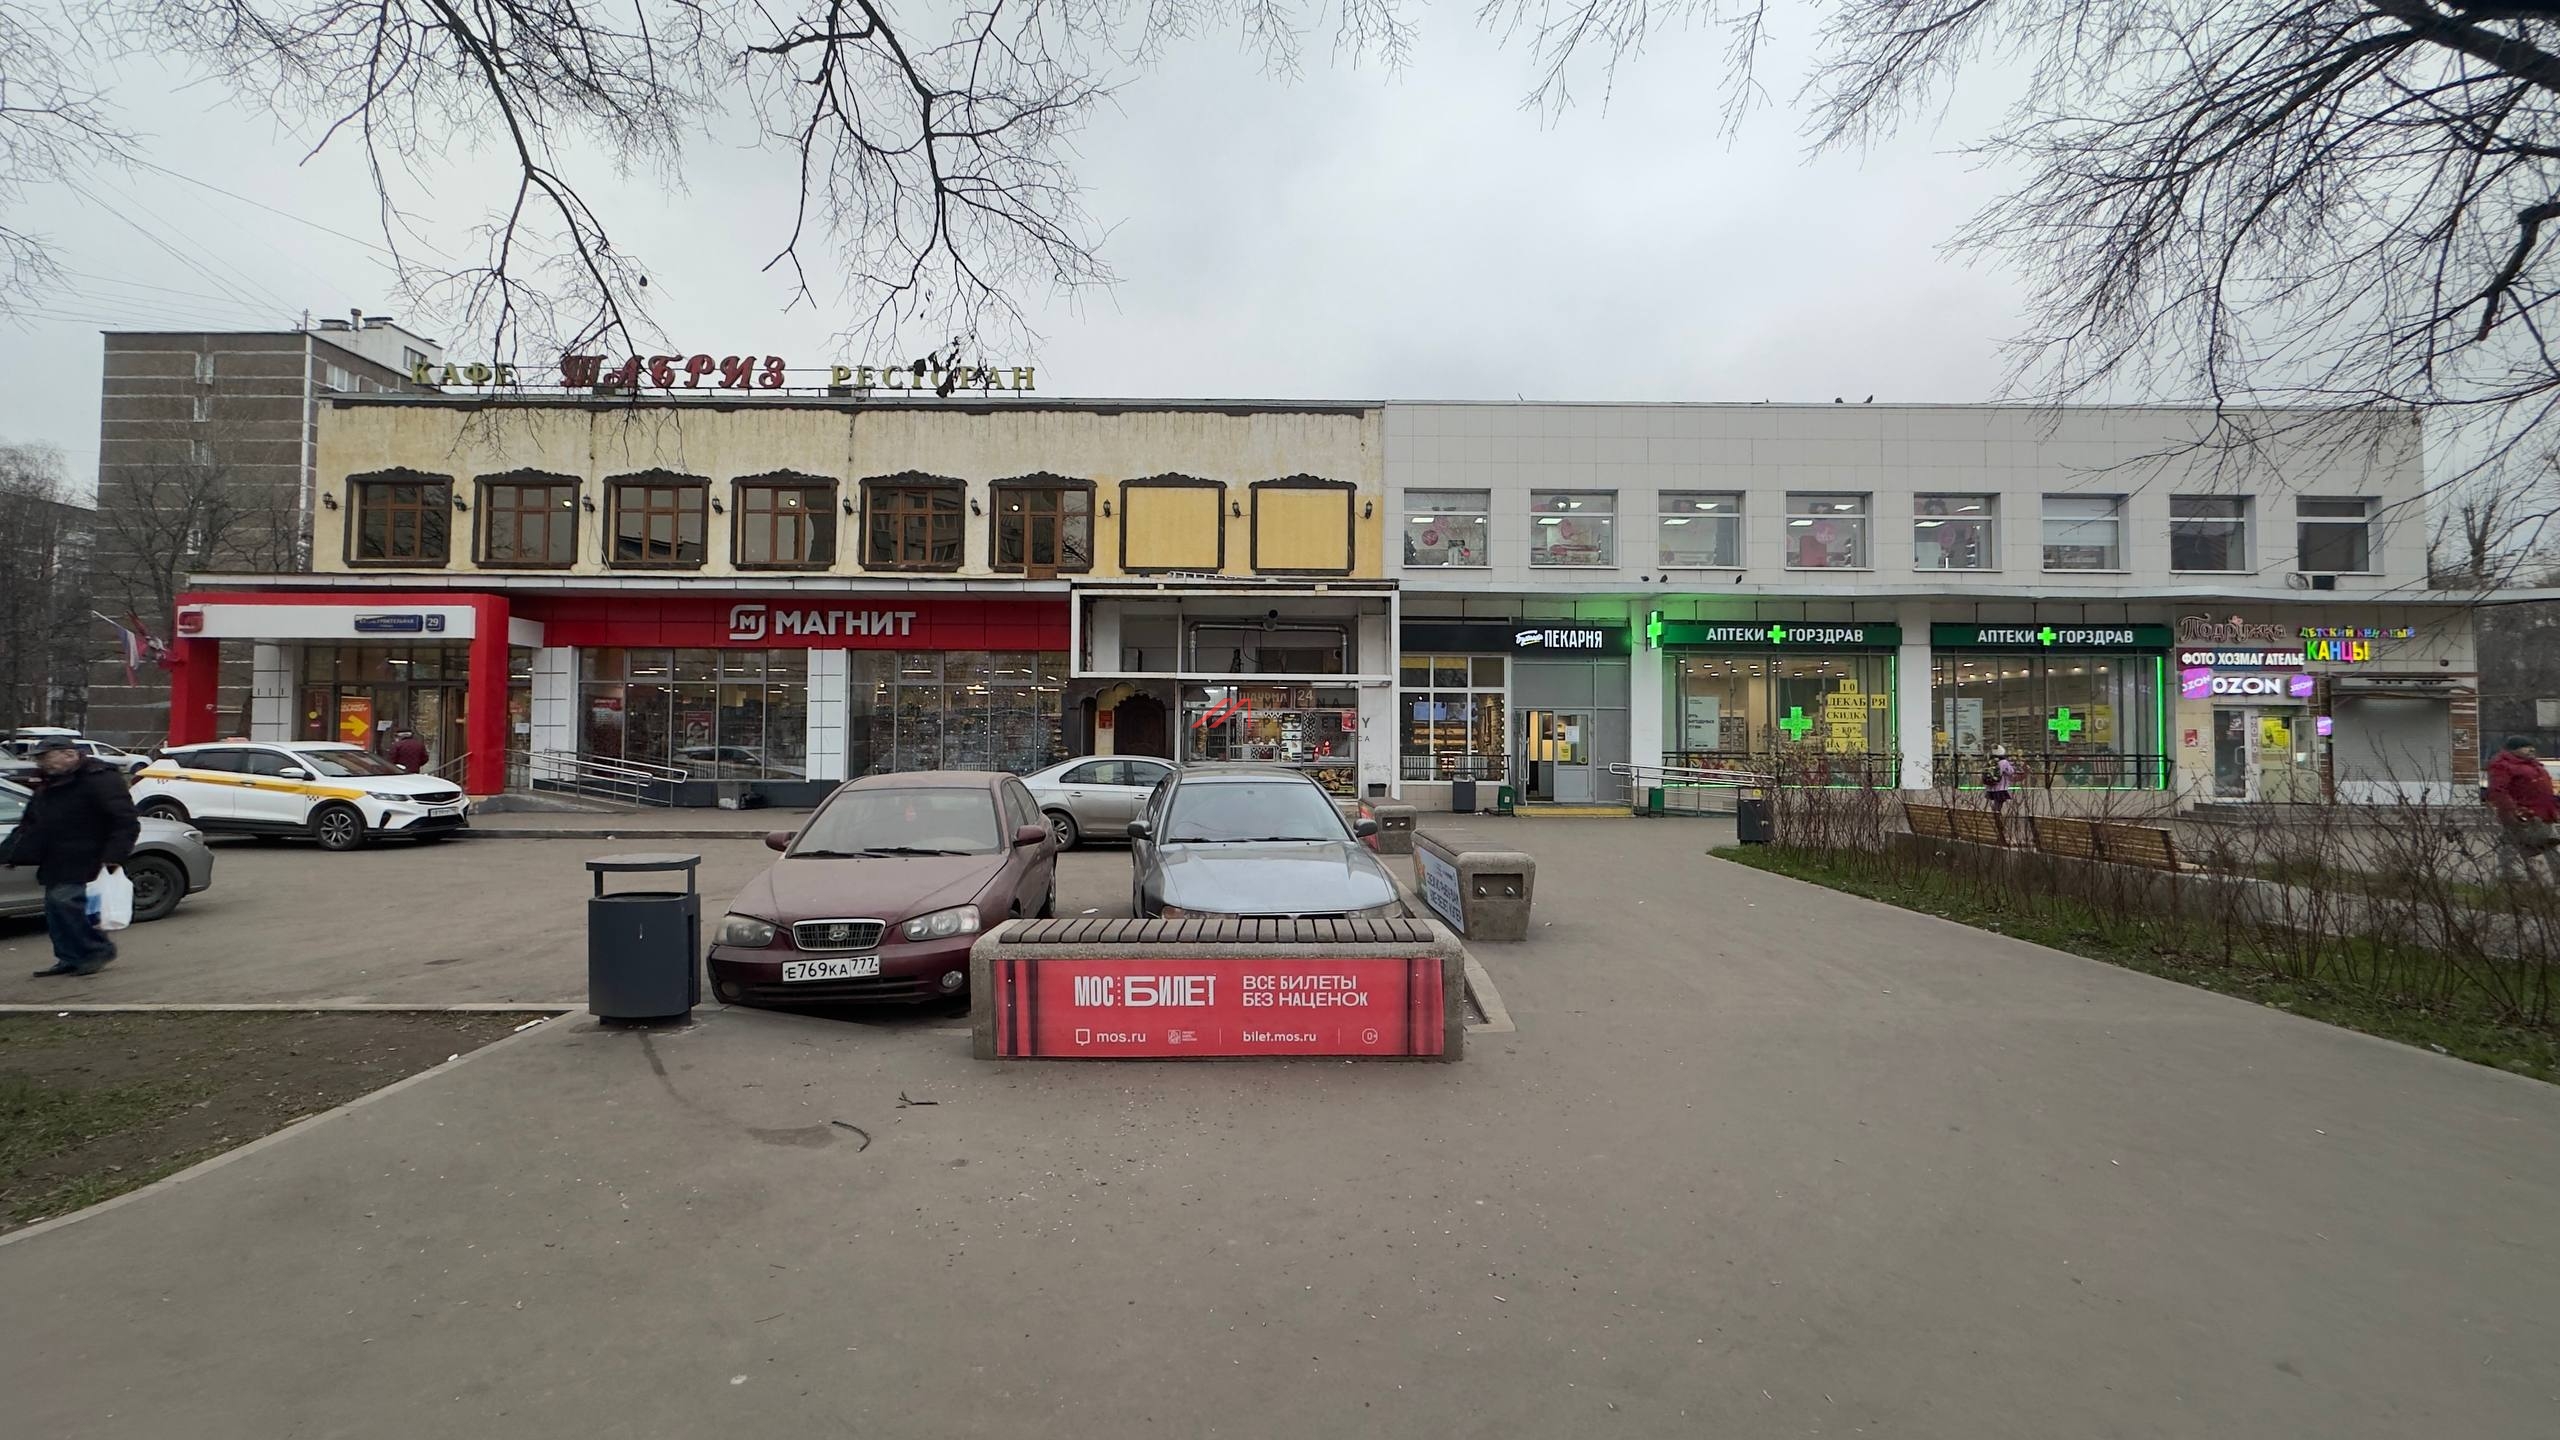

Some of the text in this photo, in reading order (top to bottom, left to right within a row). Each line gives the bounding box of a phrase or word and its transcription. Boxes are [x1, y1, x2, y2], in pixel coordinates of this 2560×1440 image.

[410, 362, 516, 386] КАФЕ
[427, 617, 439, 627] 29
[775, 611, 917, 636] МАГНИТ
[2180, 613, 2287, 642] Подружка
[1544, 630, 1603, 648] ПЕКАРНЯ
[1706, 628, 1863, 644] АПТЕКИ ГОРЗДРАВ
[1978, 630, 2133, 645] АПТЕКИ ГОРЗДРАВ
[2299, 625, 2354, 638] ДЕТСКИЙ
[2306, 640, 2370, 663] КАНЦЫ
[2182, 653, 2305, 666] ФОТО ХОЗМАГ АТЕЛЬЕ
[2212, 677, 2281, 694] OZON
[1297, 689, 1313, 701] 24
[1826, 711, 1867, 720] СКИДКА
[1243, 975, 1357, 990] ВСЕ БИЛЕТЫ
[1242, 992, 1368, 1009] БЕЗ НАЦЕНОК
[1096, 1032, 1146, 1043] mos.ru
[1243, 1031, 1317, 1042] bilet.mos.ru
